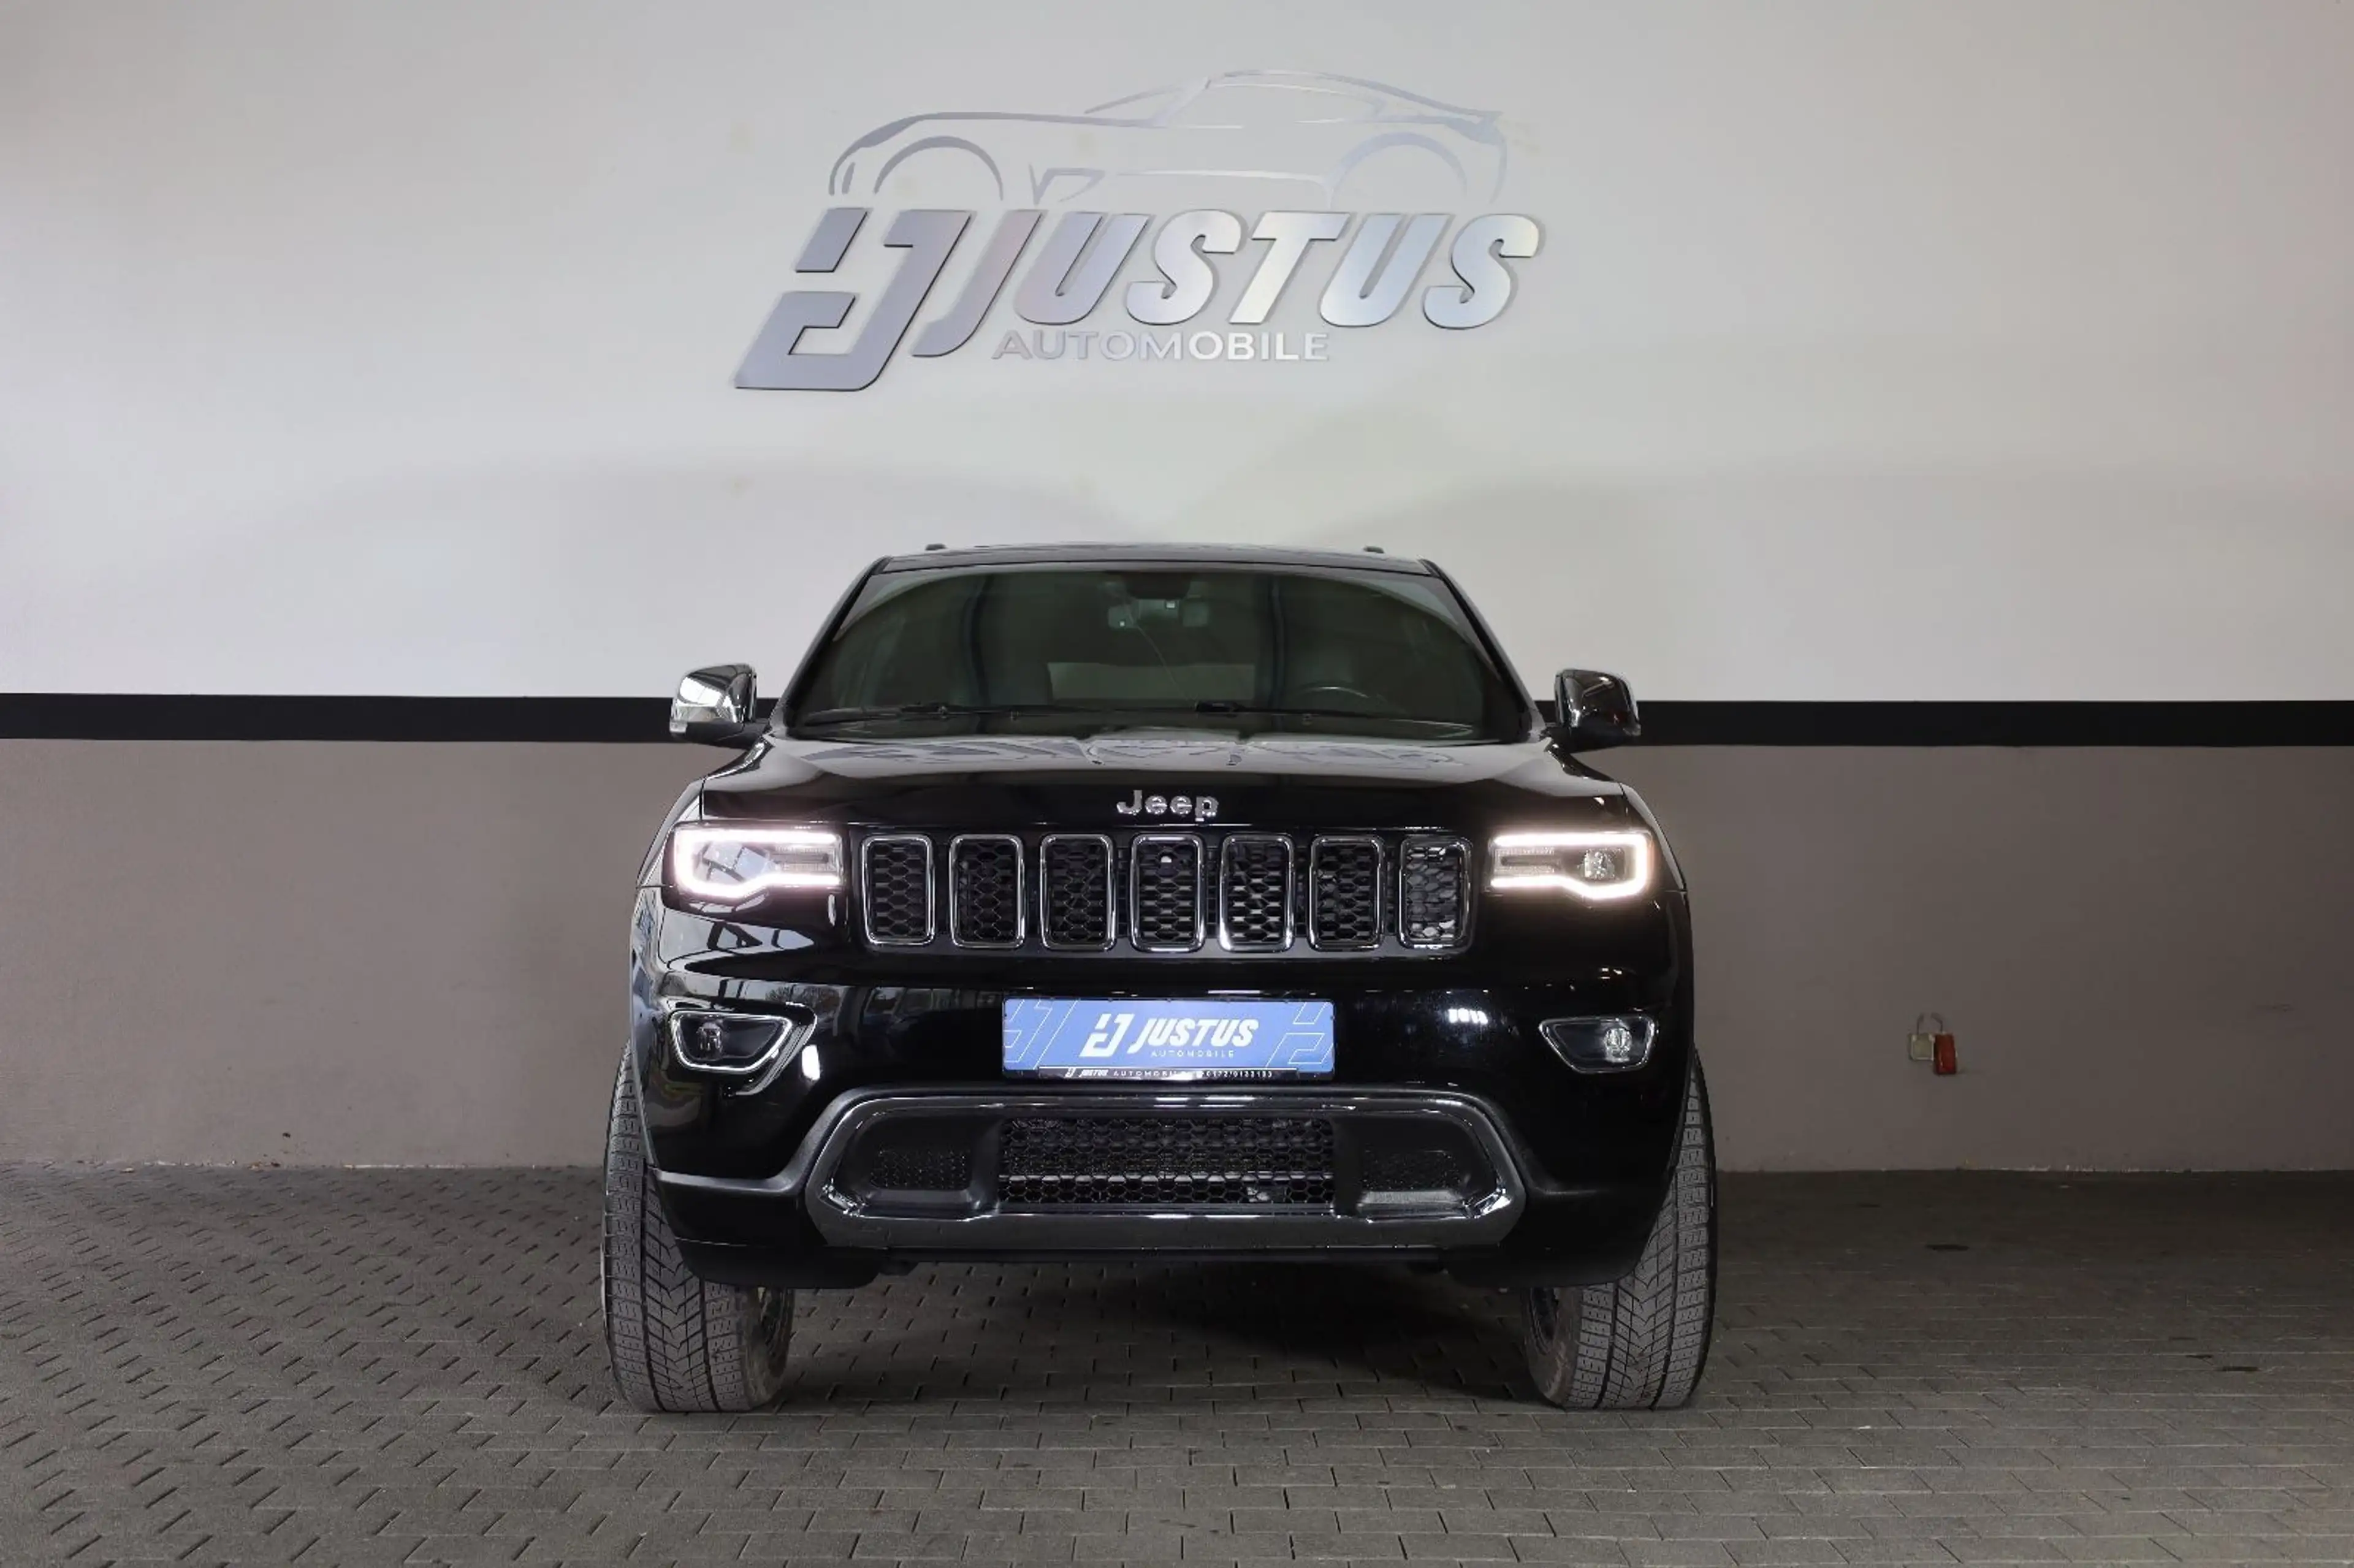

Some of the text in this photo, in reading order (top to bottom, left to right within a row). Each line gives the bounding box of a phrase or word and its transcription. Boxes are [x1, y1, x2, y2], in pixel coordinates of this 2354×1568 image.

[910, 208, 1541, 358] JUSTUS
[991, 331, 1330, 361] AUTOMOBILE
[1116, 790, 1219, 822] Jeep
[1127, 1018, 1259, 1054] JUSTUS
